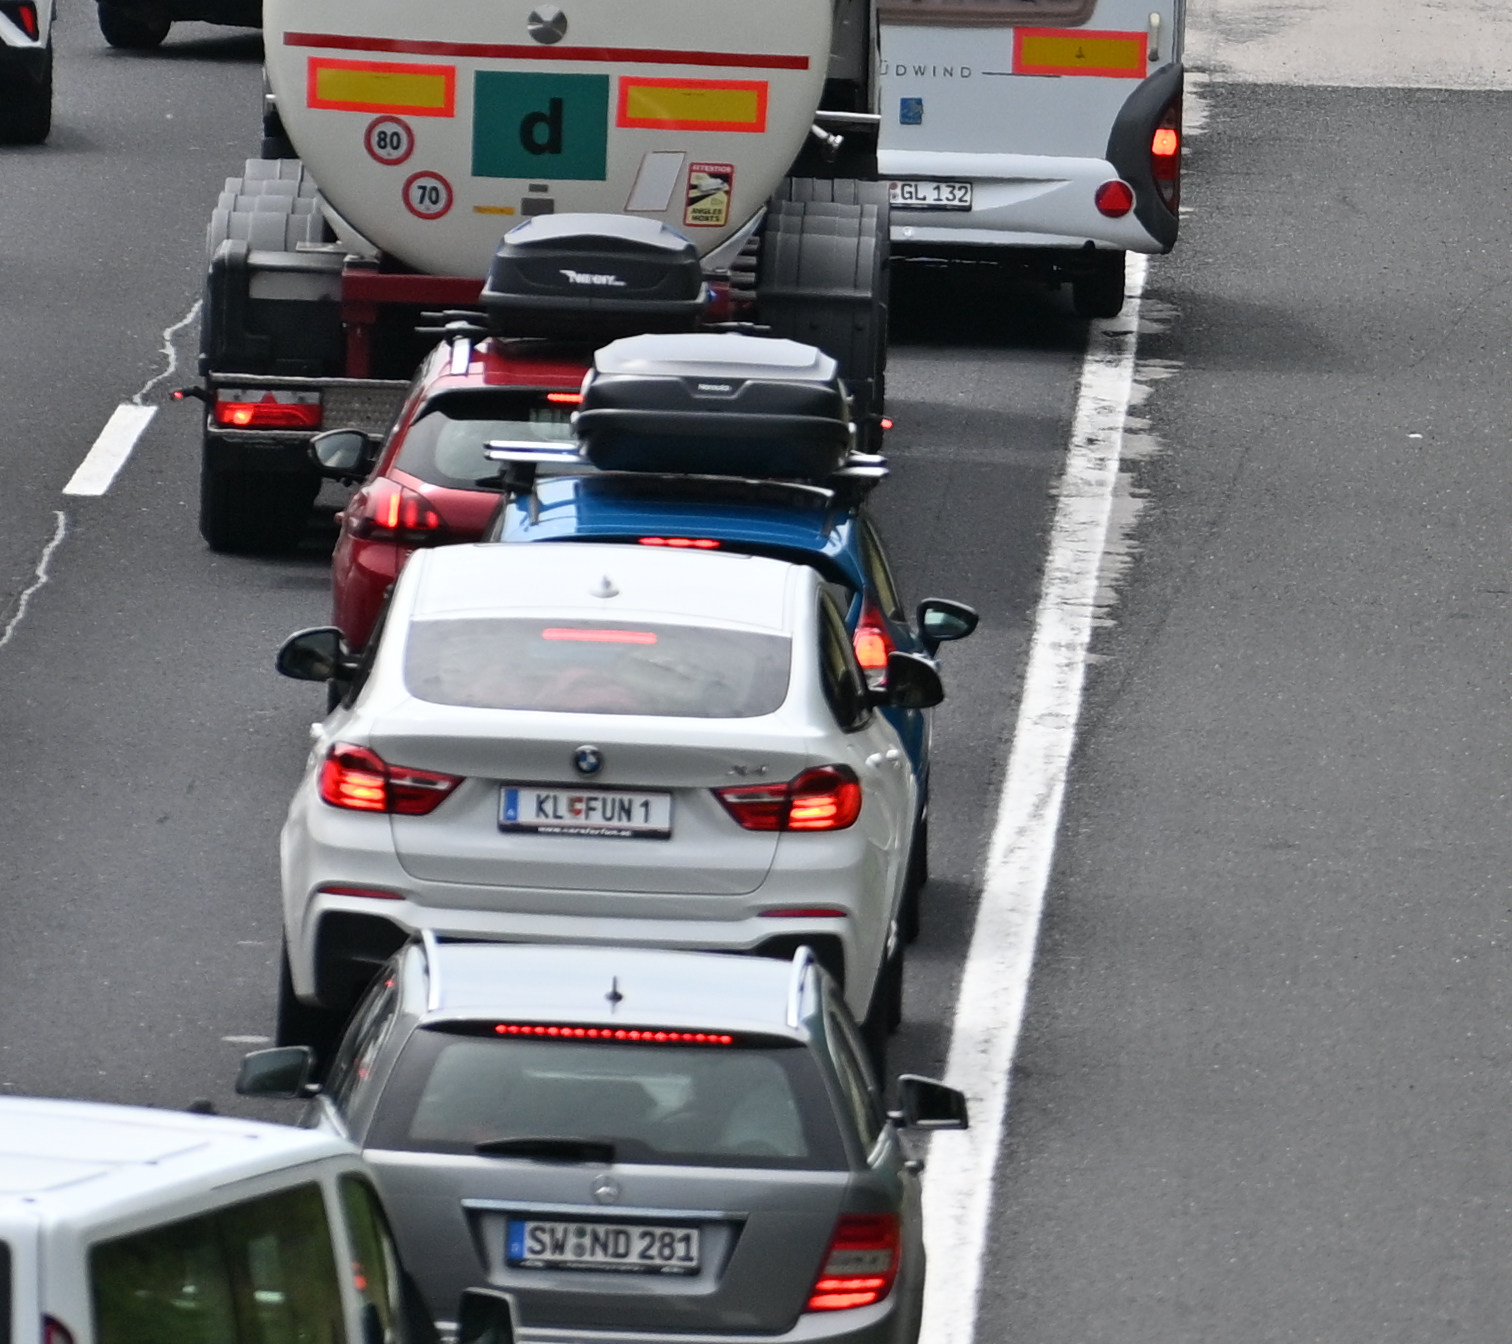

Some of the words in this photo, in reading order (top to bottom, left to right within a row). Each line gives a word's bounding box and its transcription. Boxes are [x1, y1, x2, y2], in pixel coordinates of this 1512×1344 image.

[881, 60, 972, 78] ÜDWIND
[519, 97, 563, 156] d
[377, 130, 401, 152] 80
[417, 184, 440, 207] 70
[900, 182, 927, 202] GL
[934, 183, 970, 204] 132
[536, 793, 563, 820] KL
[582, 796, 635, 824] FUN
[640, 799, 651, 824] 1
[528, 1224, 568, 1257] SW
[590, 1227, 630, 1259] ND
[638, 1230, 694, 1262] 281
